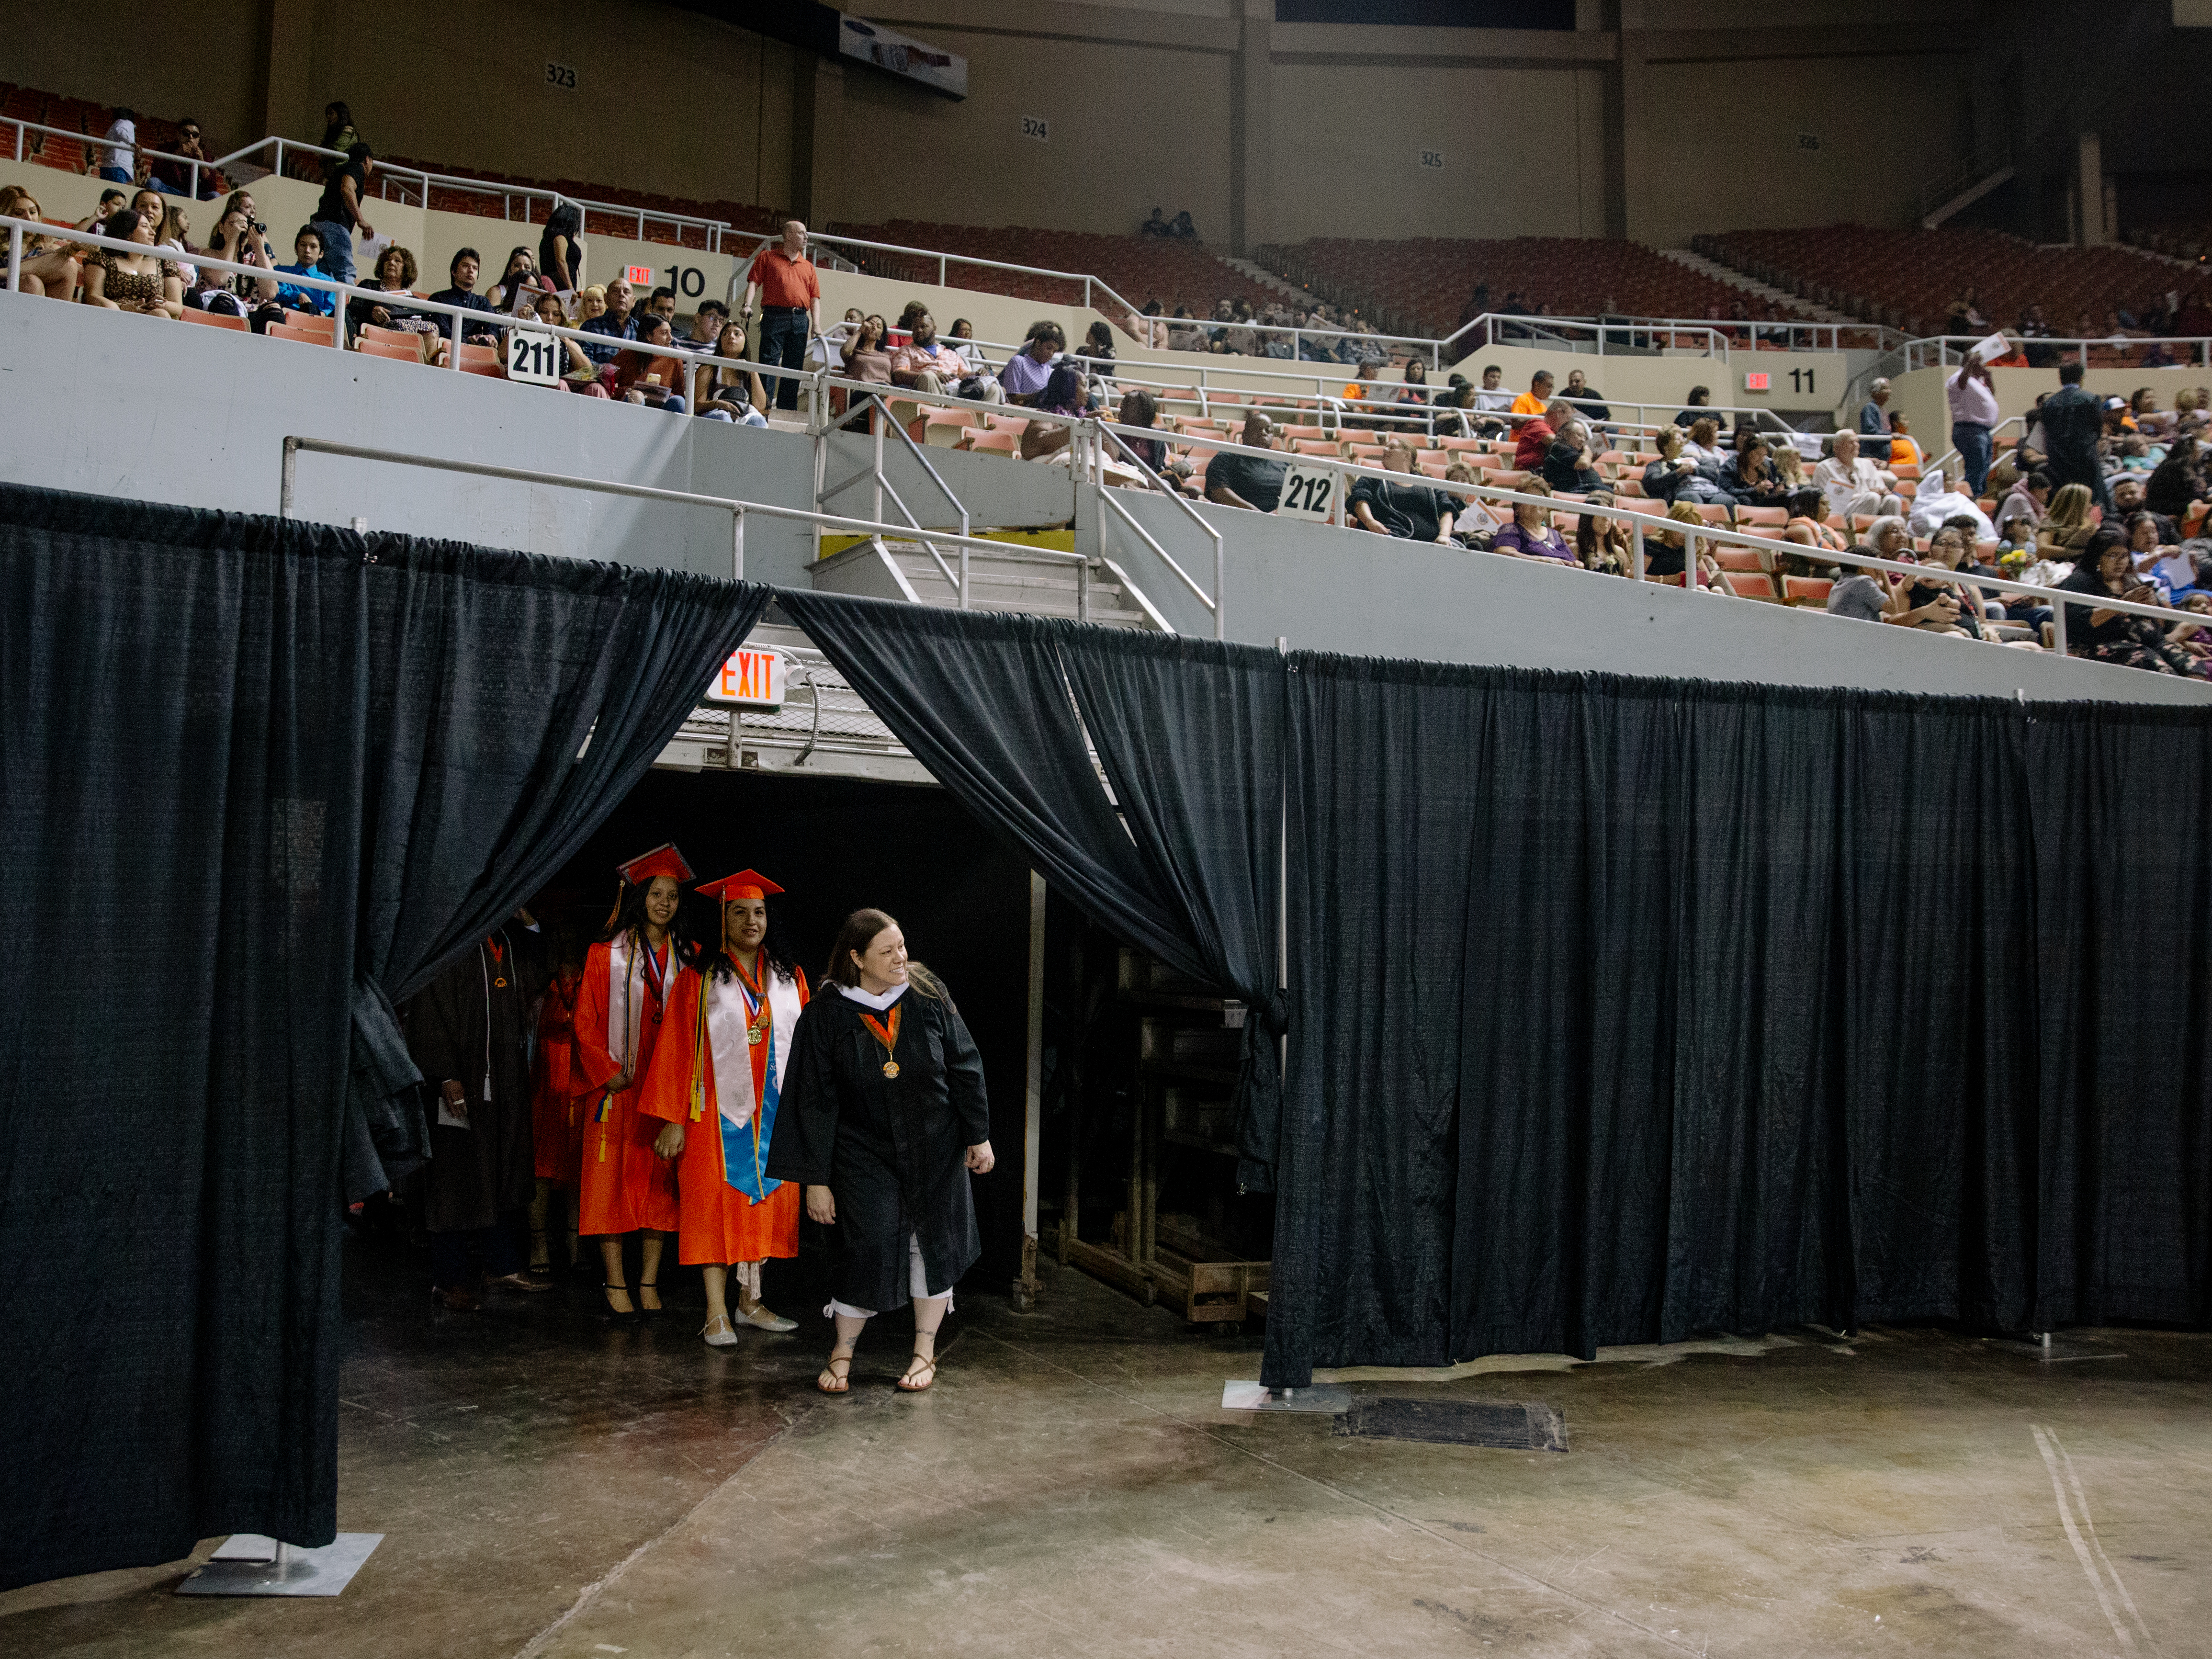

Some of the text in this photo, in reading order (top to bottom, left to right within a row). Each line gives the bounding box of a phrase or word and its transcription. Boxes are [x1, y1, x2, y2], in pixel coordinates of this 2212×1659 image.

[547, 64, 575, 88] 323
[1023, 118, 1046, 137] 324
[1422, 151, 1442, 167] 325
[628, 266, 651, 284] EXIT
[665, 265, 705, 297] 10
[513, 338, 554, 377] 211
[1788, 368, 1814, 393] 11
[1284, 474, 1331, 513] 212
[722, 651, 775, 700] EXIT
